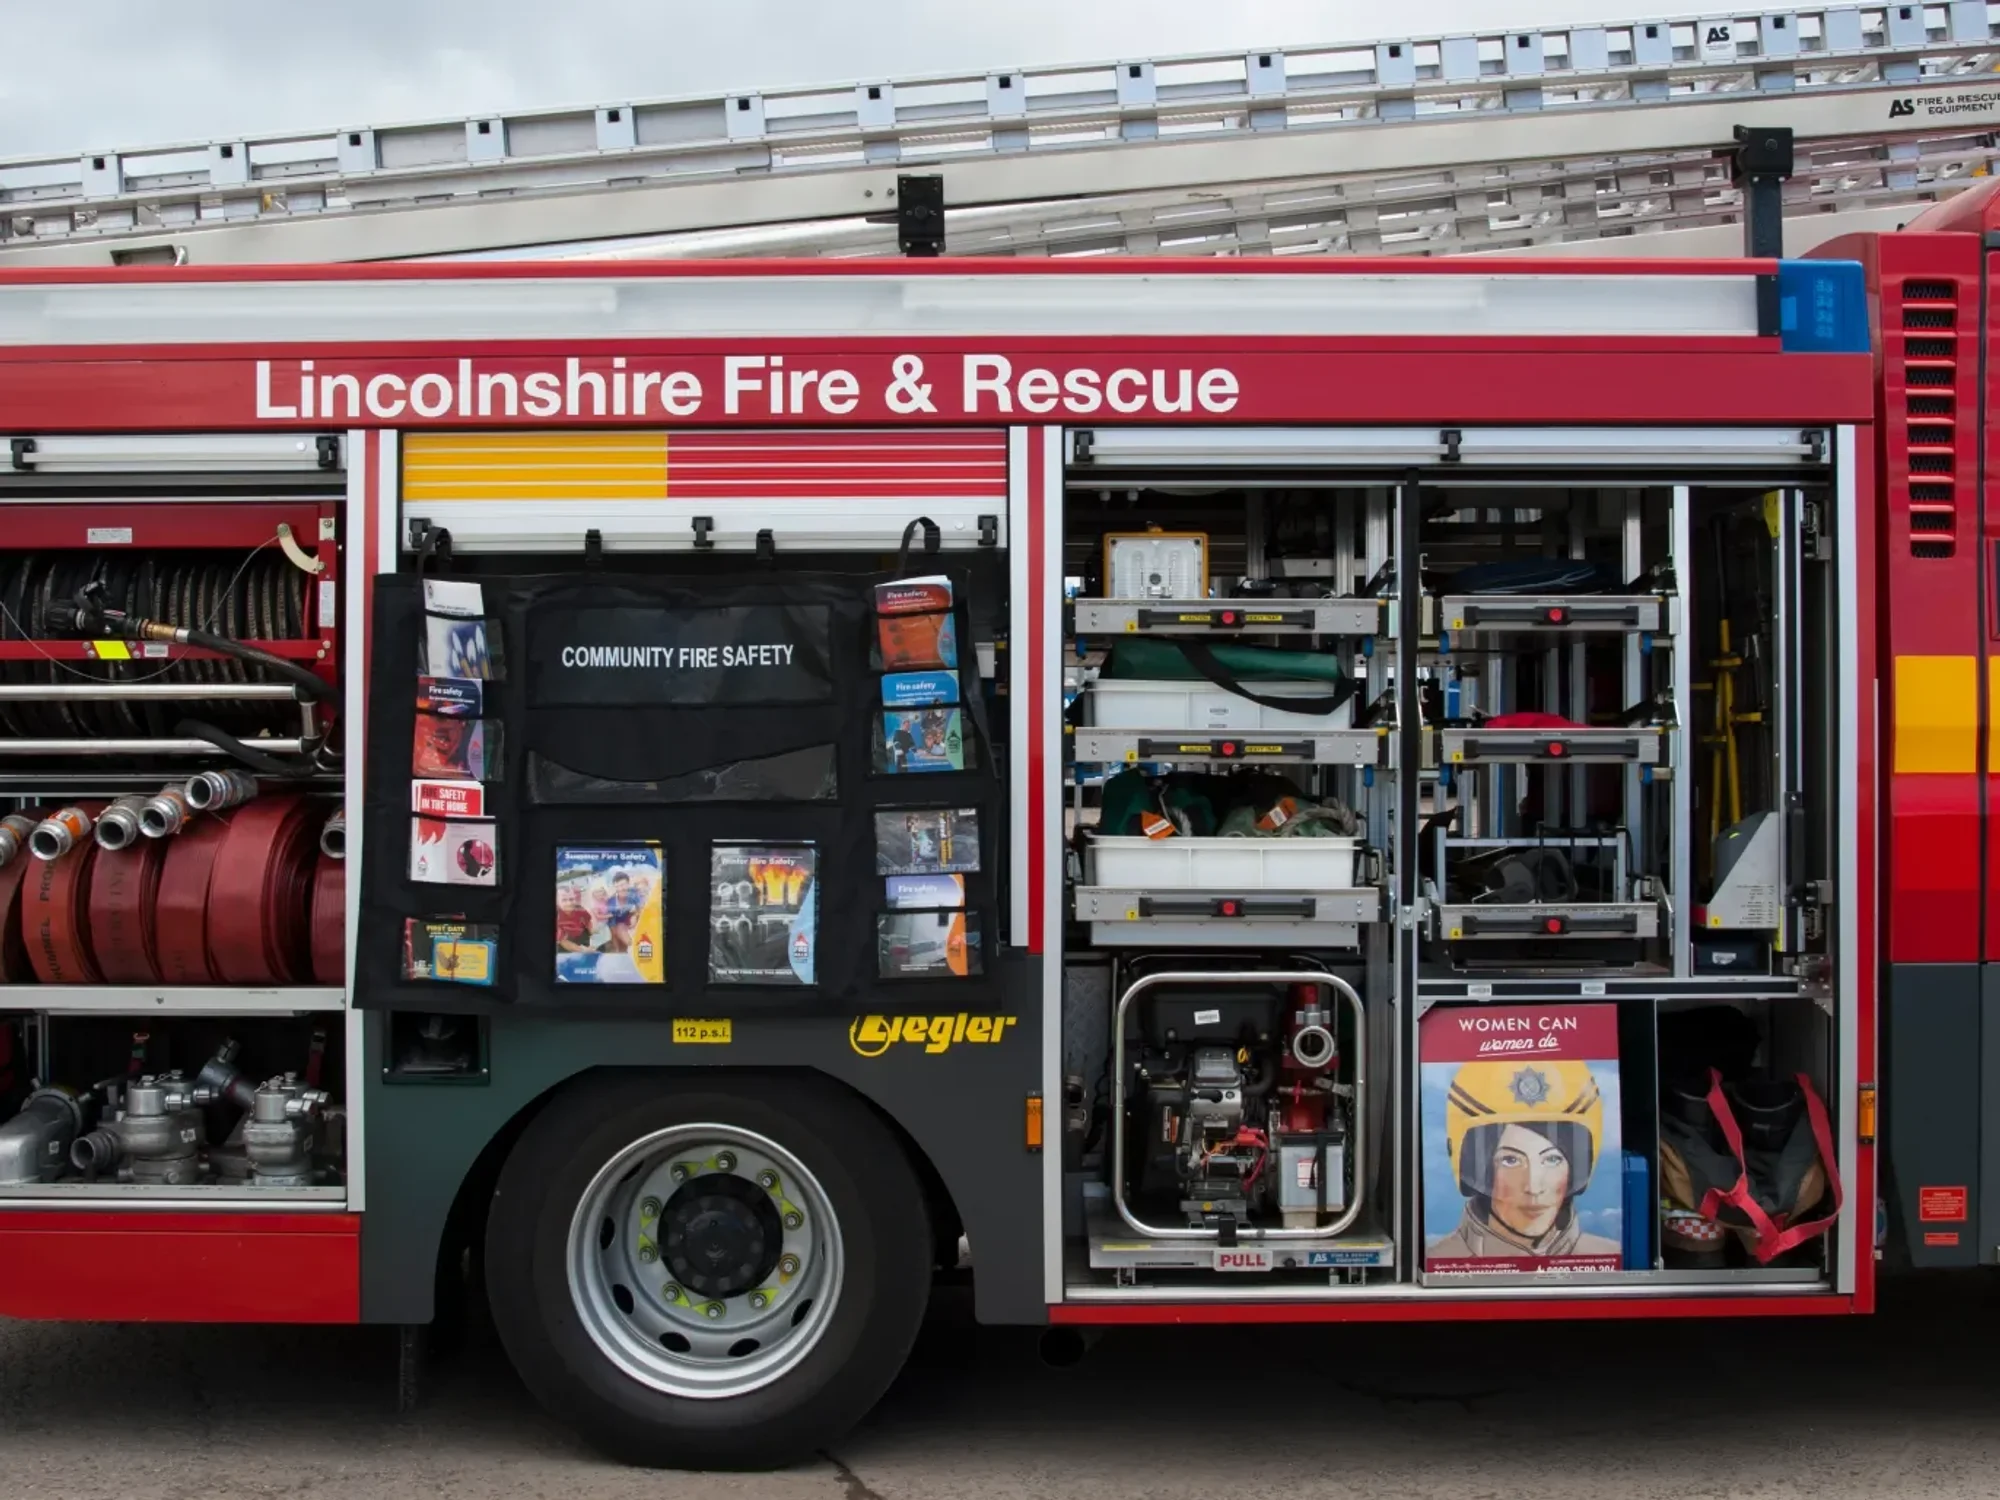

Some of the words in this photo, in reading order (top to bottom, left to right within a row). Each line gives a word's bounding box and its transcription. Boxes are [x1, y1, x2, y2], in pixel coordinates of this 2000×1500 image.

[1706, 27, 1730, 45] AS
[1917, 97, 1943, 106] FIRE
[1946, 96, 1955, 104] &
[1889, 98, 1915, 119] AS
[1928, 102, 1994, 115] EQUIPMENT
[256, 358, 703, 418] Lincolnshire
[724, 356, 860, 414] Fire
[885, 354, 938, 413] &
[963, 354, 1240, 413] Rescue
[562, 647, 674, 668] COMMUNITY
[679, 647, 717, 668] FIRE
[722, 644, 794, 666] SAFETY
[429, 686, 441, 694] Fire
[443, 687, 463, 697] safety
[896, 682, 911, 691] Fire
[912, 681, 936, 691] safety
[439, 788, 467, 801] SAFETY
[431, 800, 445, 811] THE
[601, 852, 618, 860] Fire
[620, 852, 647, 861] Safety
[769, 858, 796, 866] Safety
[899, 885, 912, 893] Fire
[1459, 1018, 1530, 1032] WOMEN
[1539, 1017, 1577, 1030] CAN
[676, 1027, 697, 1037] 112
[700, 1027, 729, 1040] p.s.i.
[1480, 1038, 1533, 1051] women
[1538, 1033, 1559, 1047] do
[1220, 1254, 1266, 1267] PULL
